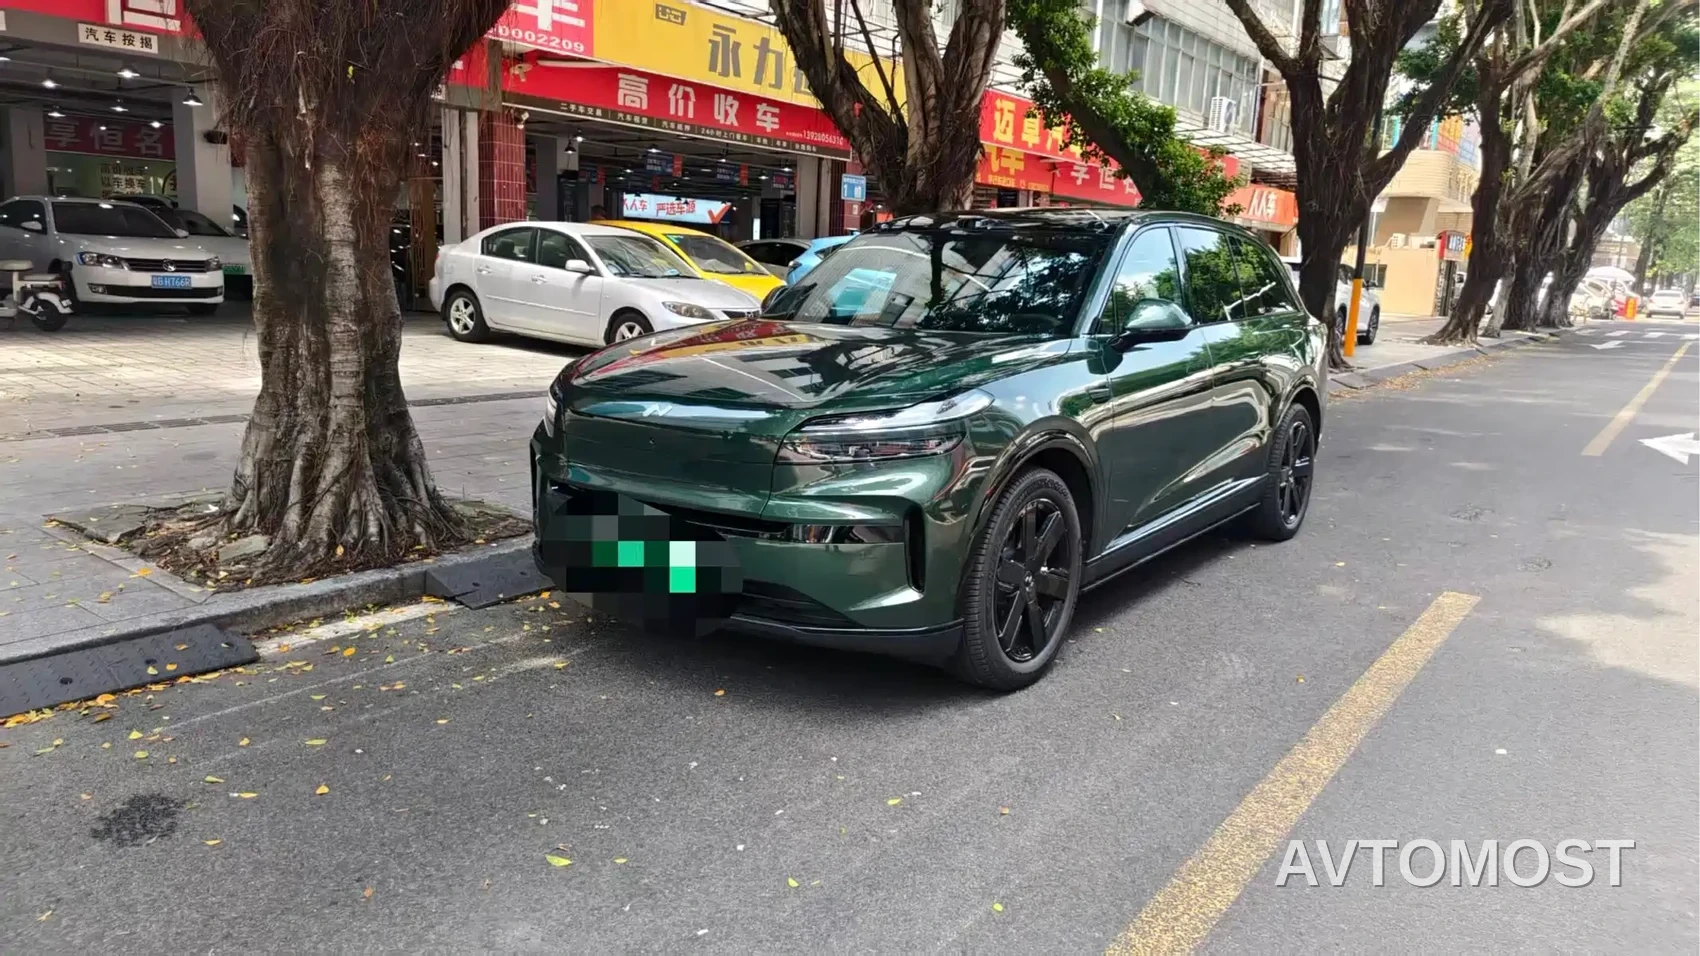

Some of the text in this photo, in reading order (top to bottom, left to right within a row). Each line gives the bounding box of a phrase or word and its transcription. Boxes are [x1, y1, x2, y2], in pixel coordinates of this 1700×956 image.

[85, 27, 153, 50] 汽车按揭
[488, 25, 585, 53] 0002209
[709, 24, 815, 95] 永力
[617, 73, 780, 132] 高价收车
[656, 200, 696, 217] 严选车源
